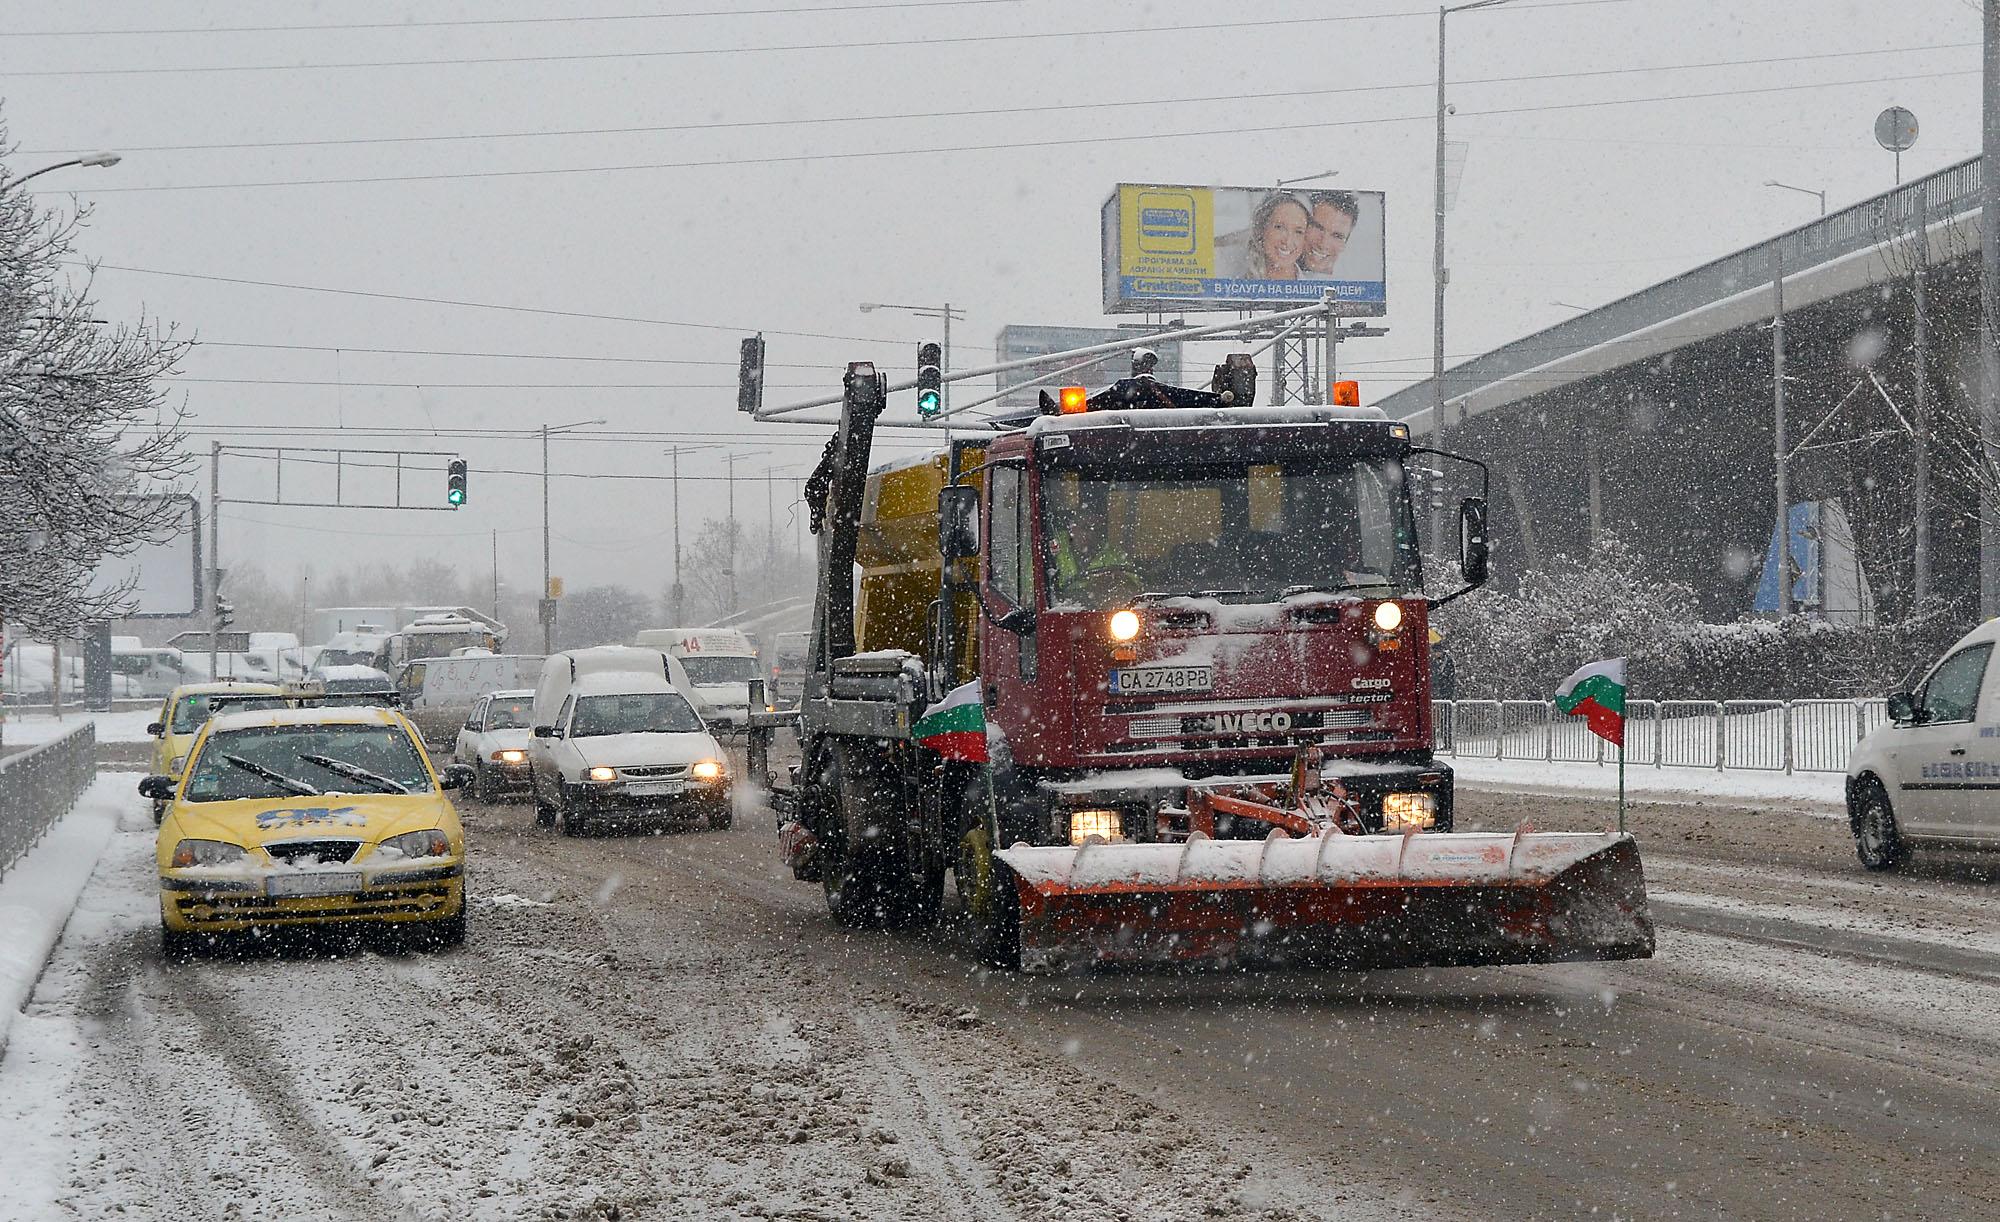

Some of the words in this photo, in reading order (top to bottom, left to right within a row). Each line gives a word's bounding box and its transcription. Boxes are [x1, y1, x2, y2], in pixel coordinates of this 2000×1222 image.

[1214, 283, 1222, 293] В
[1225, 283, 1265, 294] УСЛУГА
[1267, 284, 1282, 294] НА
[682, 637, 700, 653] 14
[1120, 673, 1142, 689] CA
[1145, 671, 1184, 688] 2748
[1187, 670, 1208, 687] PB
[1350, 677, 1391, 689] Cargo
[1350, 693, 1391, 703] tector
[1214, 711, 1292, 733] IVECO
